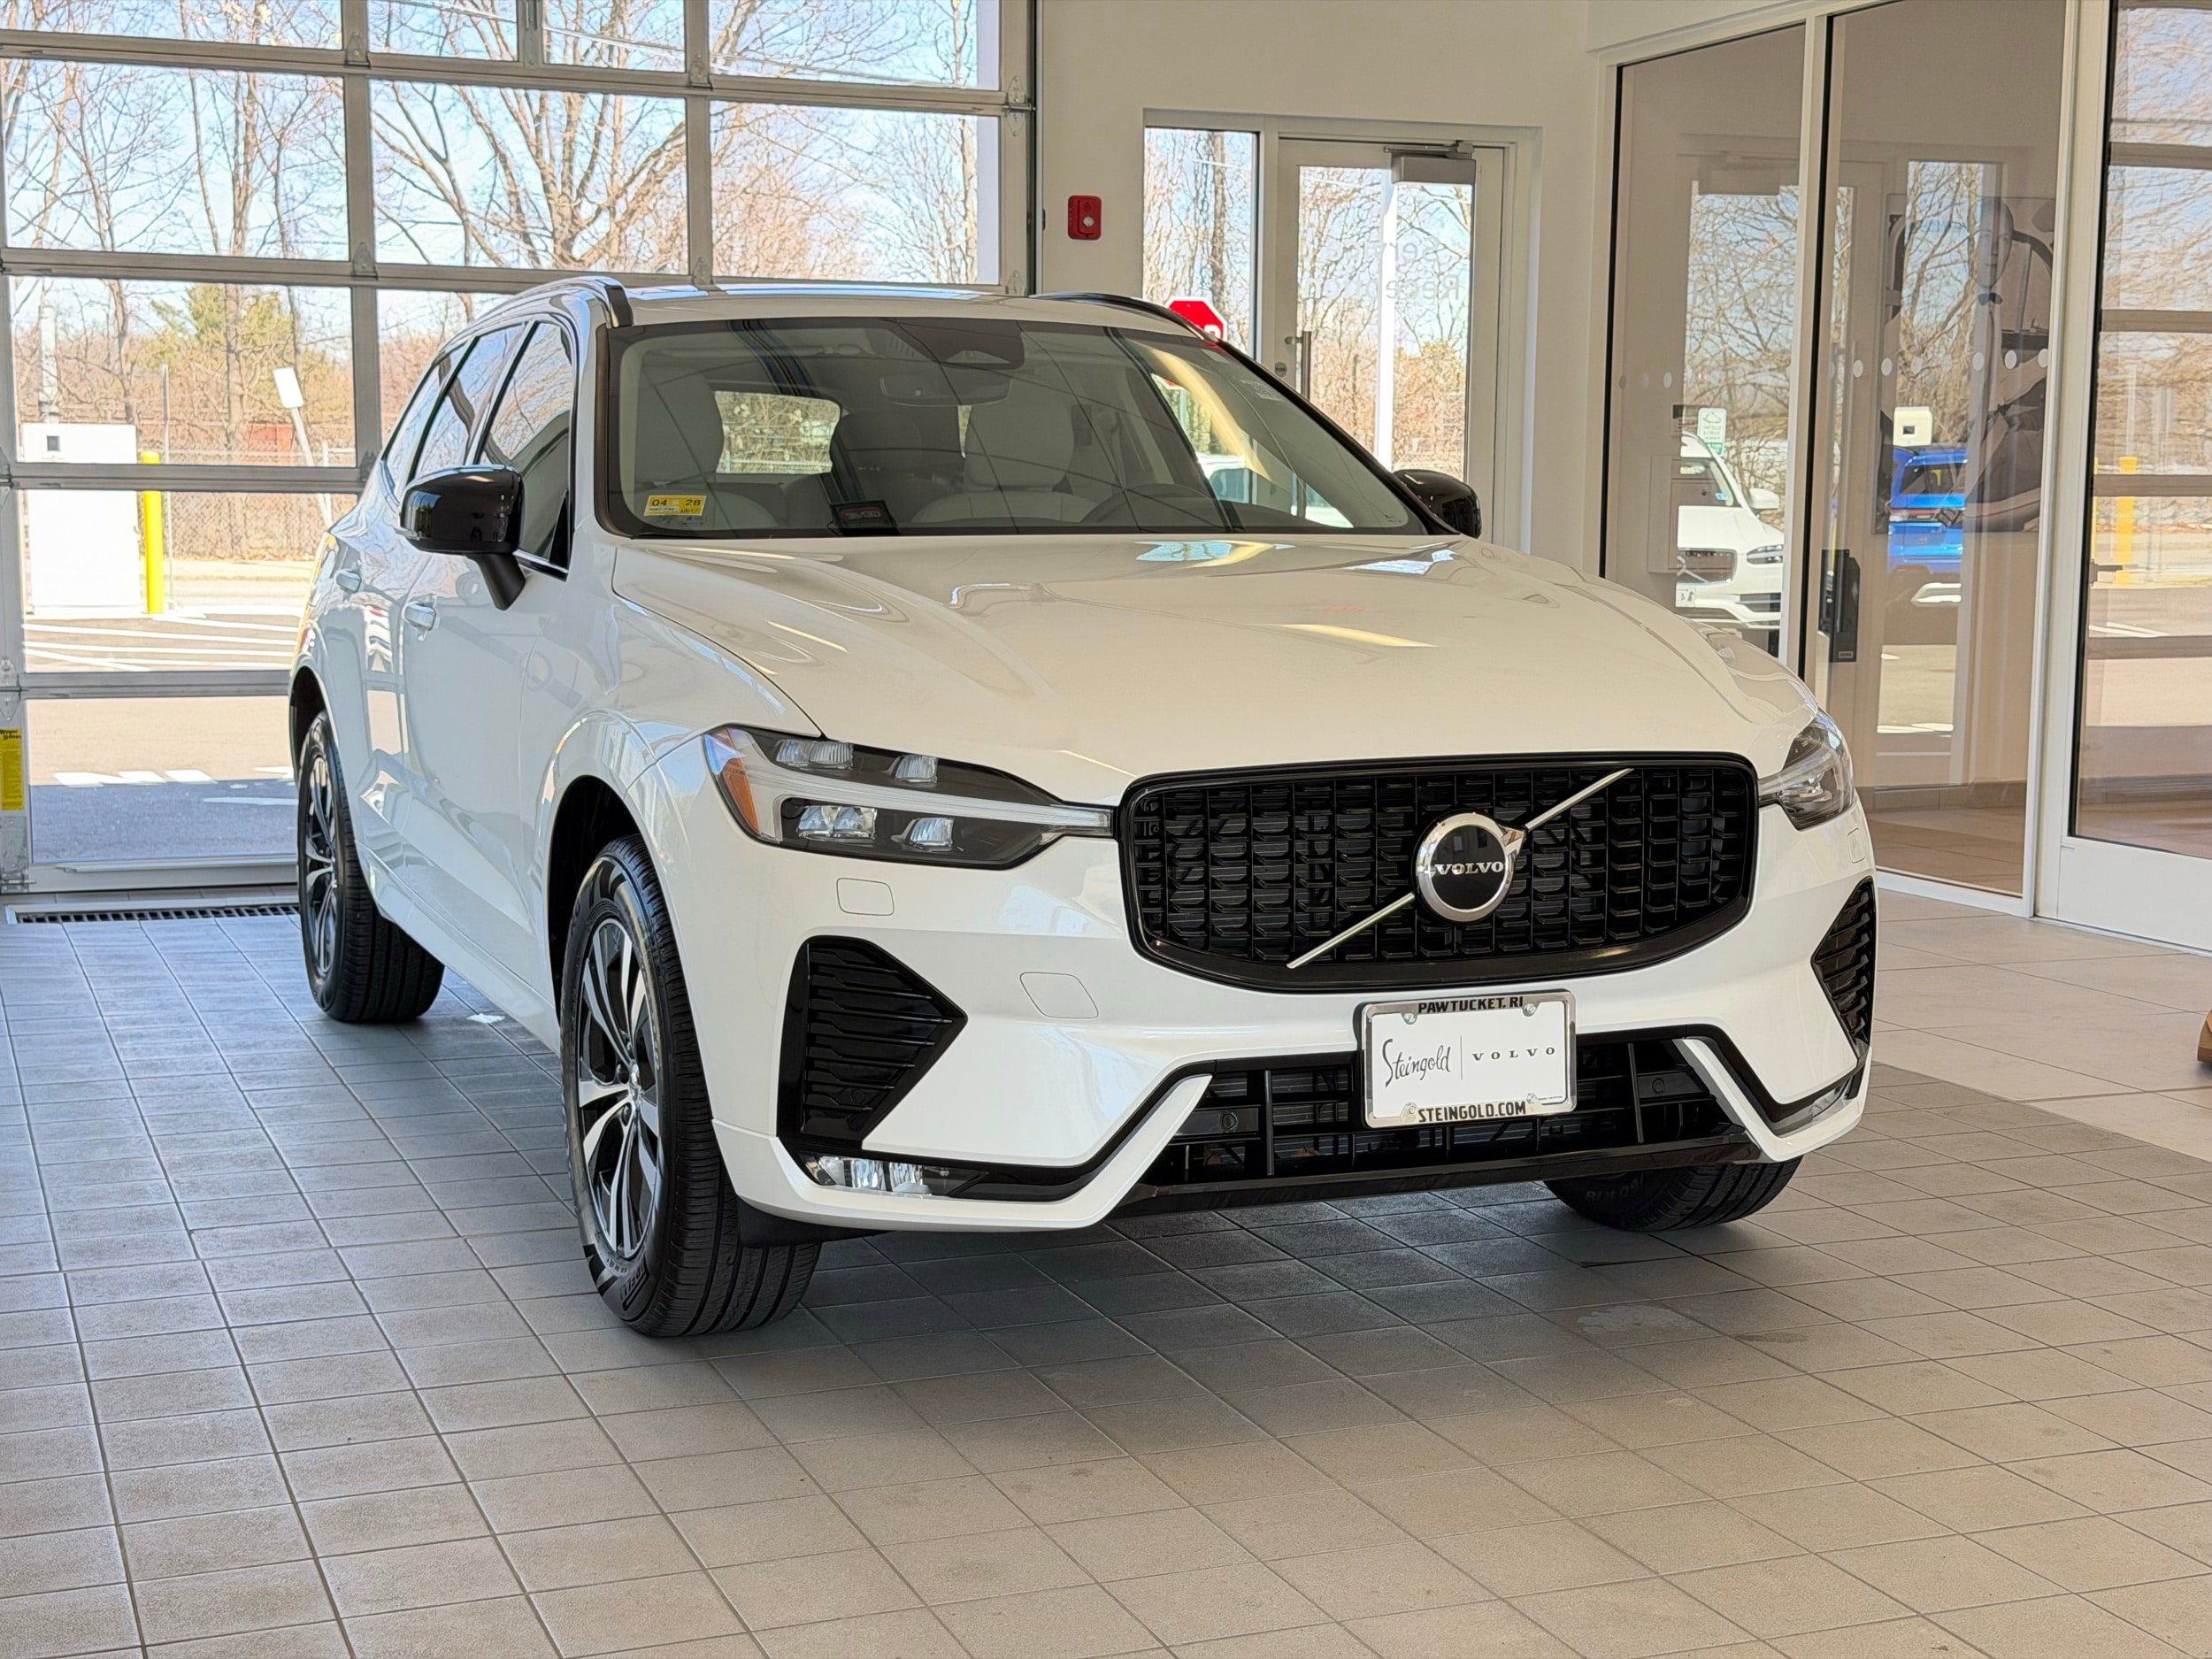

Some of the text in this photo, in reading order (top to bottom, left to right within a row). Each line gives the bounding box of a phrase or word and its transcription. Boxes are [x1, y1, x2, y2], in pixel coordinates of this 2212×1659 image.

[1433, 861, 1504, 875] VOLVO
[1509, 996, 1524, 1008] RI
[1382, 1038, 1555, 1087] Steingold VOLVO
[1418, 1101, 1526, 1123] STEINGOLD.COM
